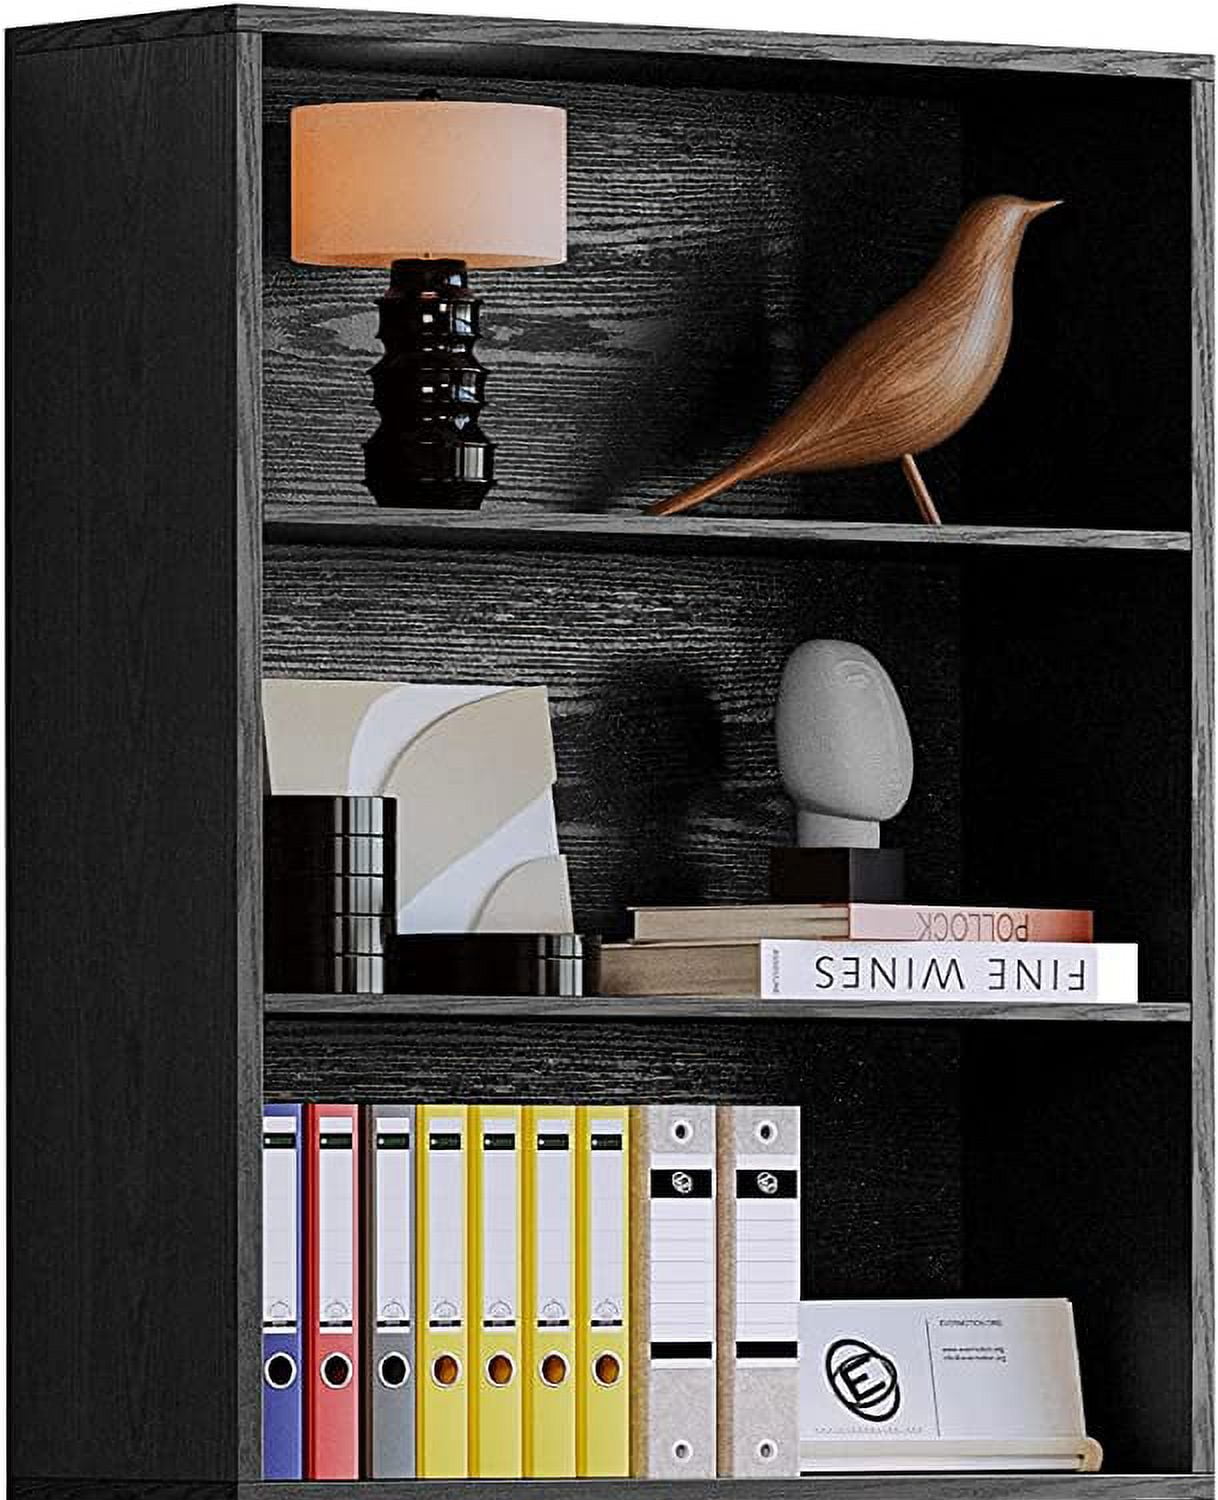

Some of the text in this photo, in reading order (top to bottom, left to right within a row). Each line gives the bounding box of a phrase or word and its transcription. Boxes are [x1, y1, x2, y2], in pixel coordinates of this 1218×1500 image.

[917, 911, 1029, 942] POLLOCK
[815, 955, 1085, 991] FINE WINES
